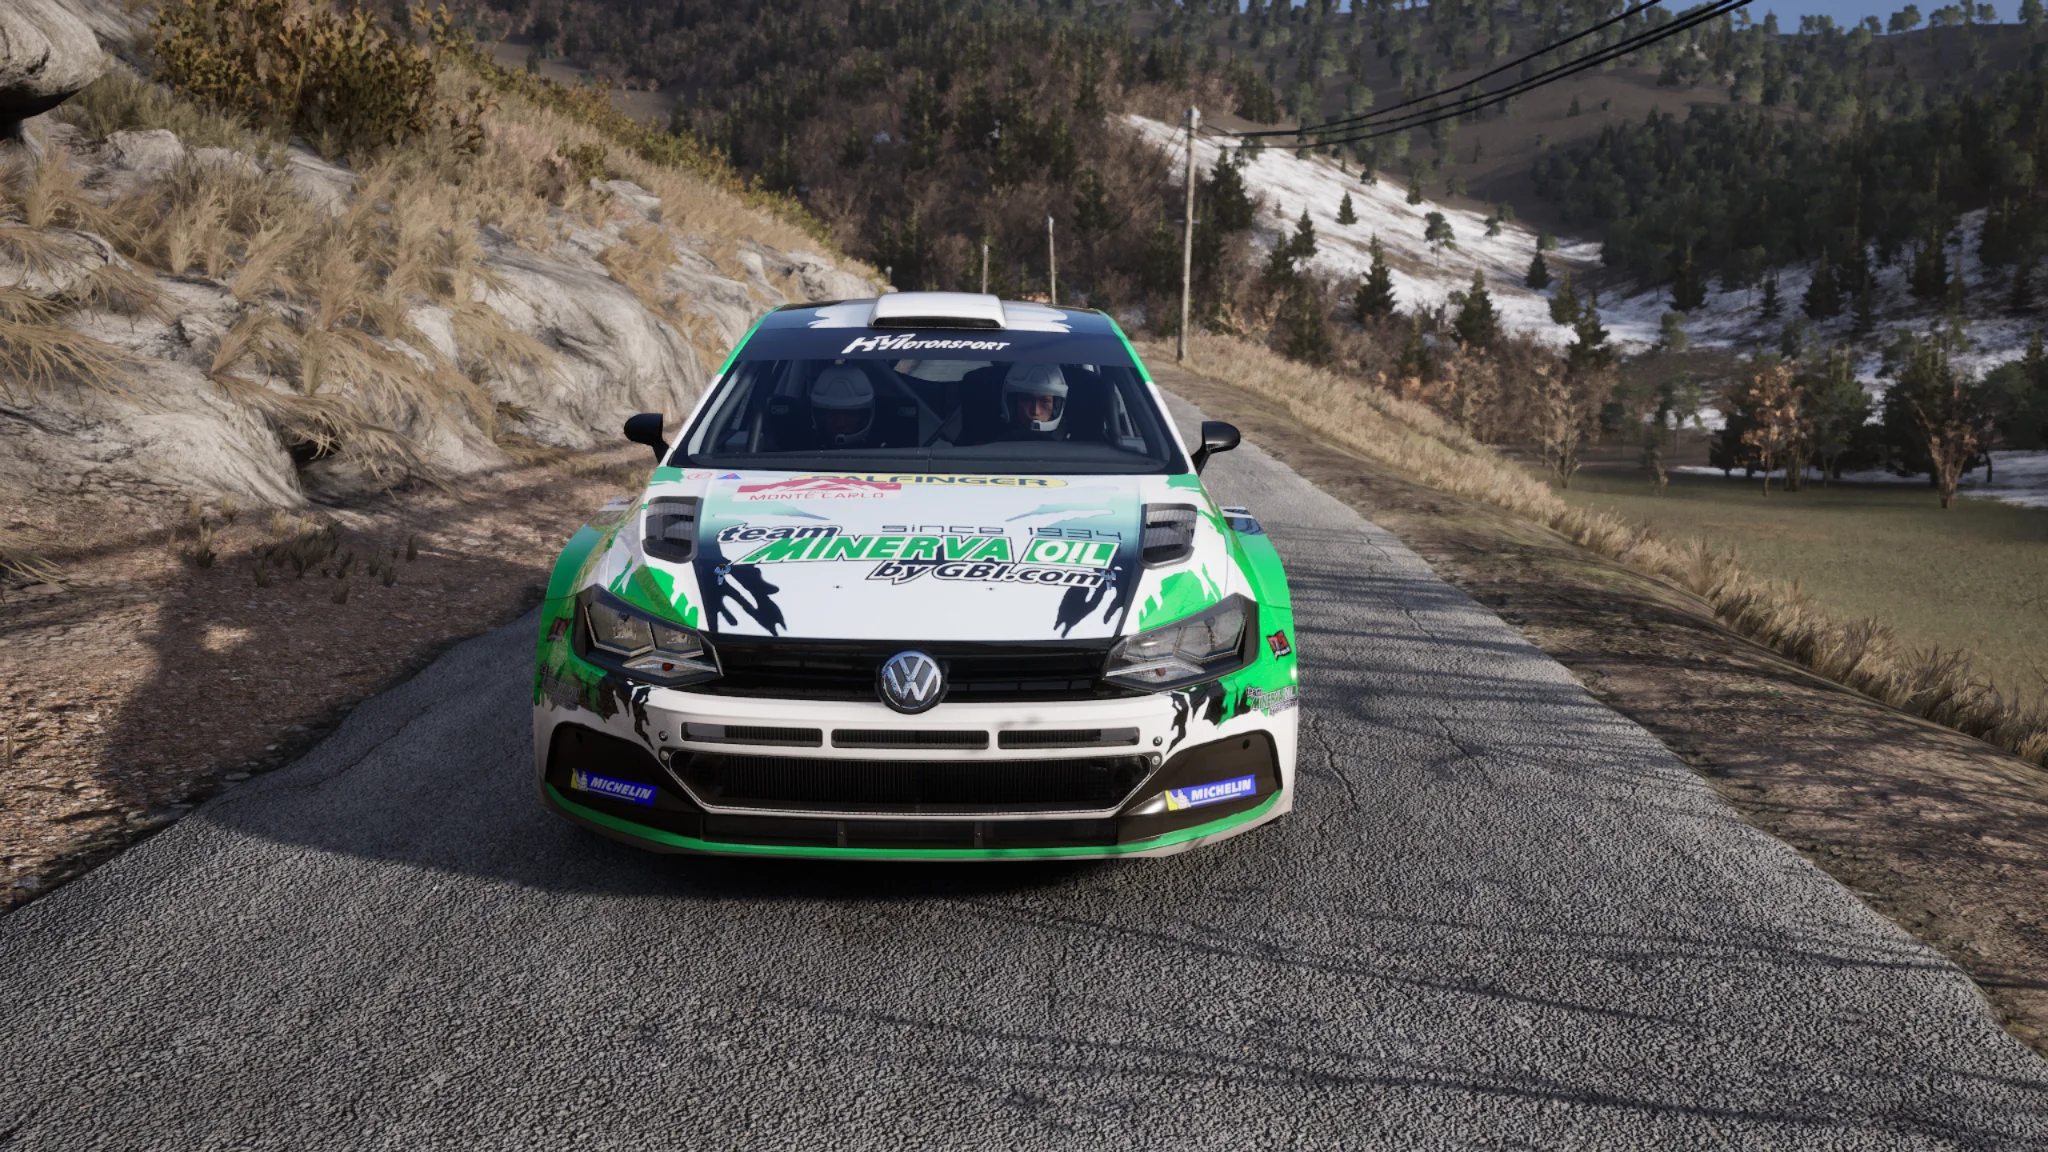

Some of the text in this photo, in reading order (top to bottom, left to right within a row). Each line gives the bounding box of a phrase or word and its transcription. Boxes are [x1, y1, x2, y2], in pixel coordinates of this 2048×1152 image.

[749, 492, 815, 501] MONTE
[719, 523, 840, 542] team
[1028, 526, 1122, 540] 1934
[738, 535, 1109, 566] MINERVA OIL
[873, 562, 1103, 586] by GBI.com
[590, 776, 653, 799] MICHELIN
[1191, 778, 1251, 801] MICHELIN
